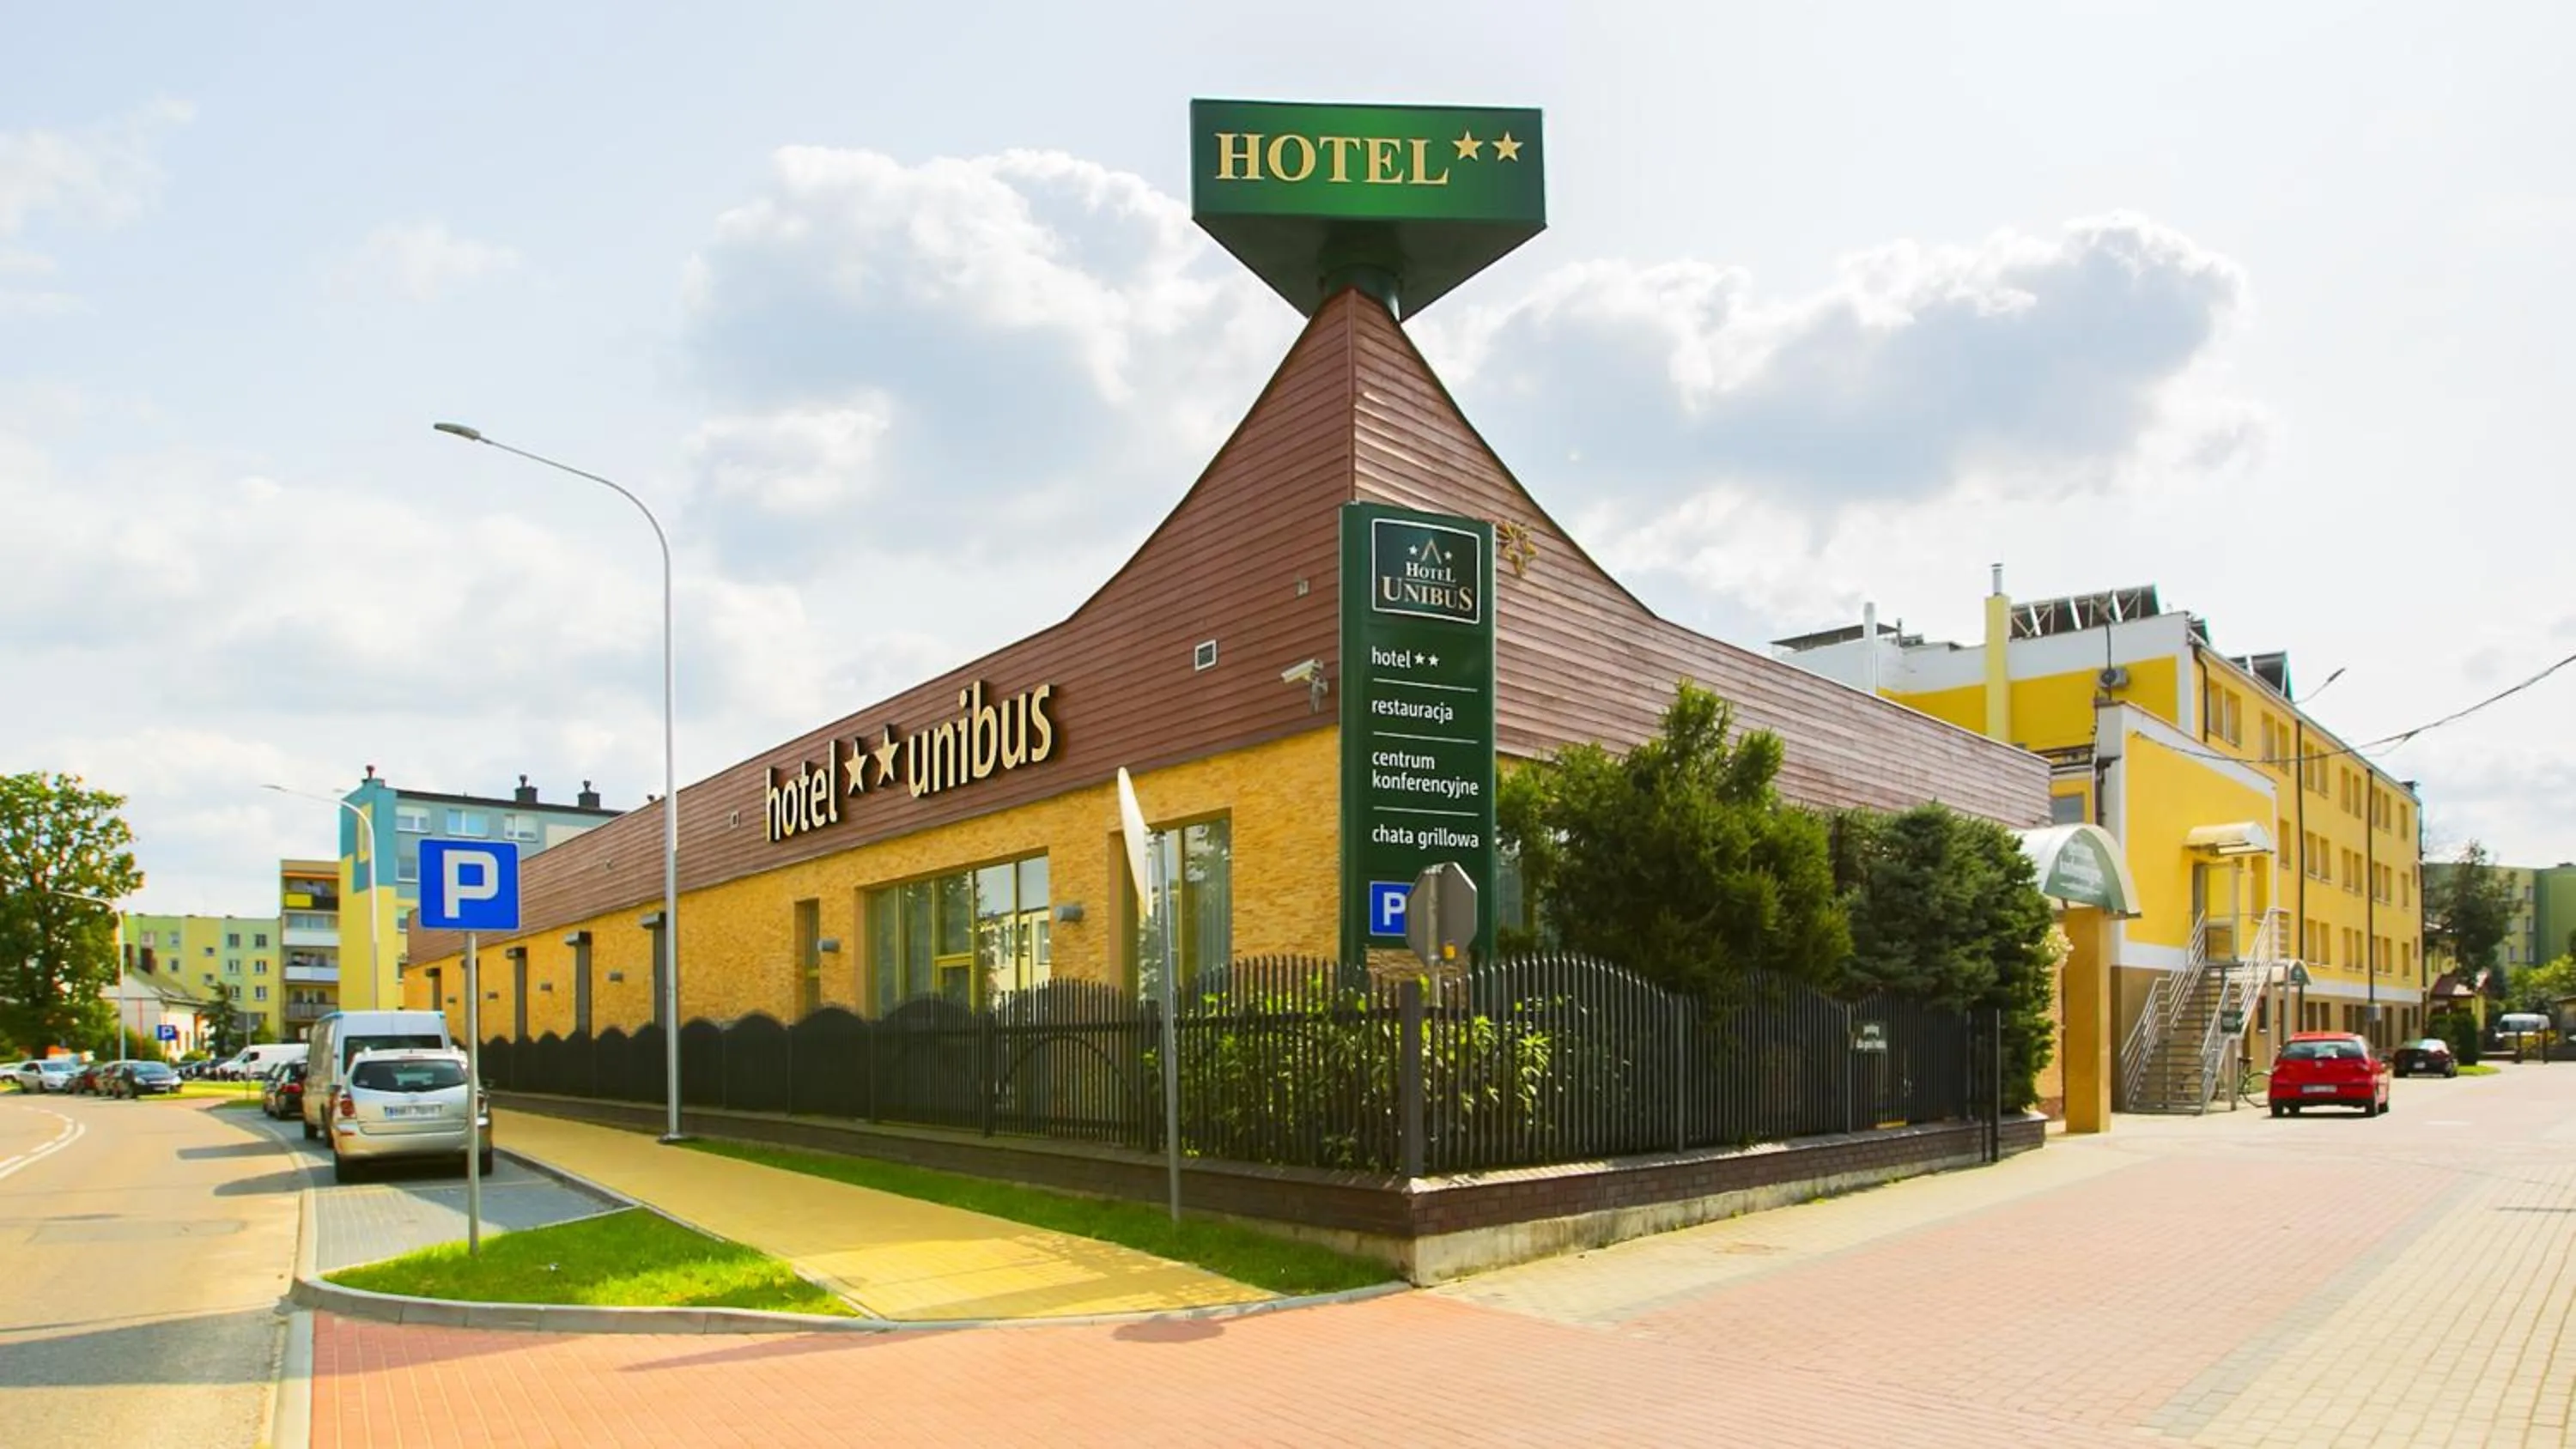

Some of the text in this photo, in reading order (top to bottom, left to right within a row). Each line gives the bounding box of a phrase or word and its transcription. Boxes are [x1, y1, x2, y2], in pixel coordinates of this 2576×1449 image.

[1214, 132, 1449, 185] HOTEL
[1406, 561, 1456, 583] HOTEL
[1383, 576, 1473, 612] UNIBUS
[1372, 646, 1411, 668] hotel
[1372, 700, 1453, 724] restauracja
[766, 680, 1053, 841] hotel unibus
[1372, 751, 1435, 769] centrum
[1372, 769, 1479, 798] konferencyjne
[1372, 824, 1479, 850] chata grillowa
[444, 850, 499, 919] P
[1383, 892, 1406, 925] P
